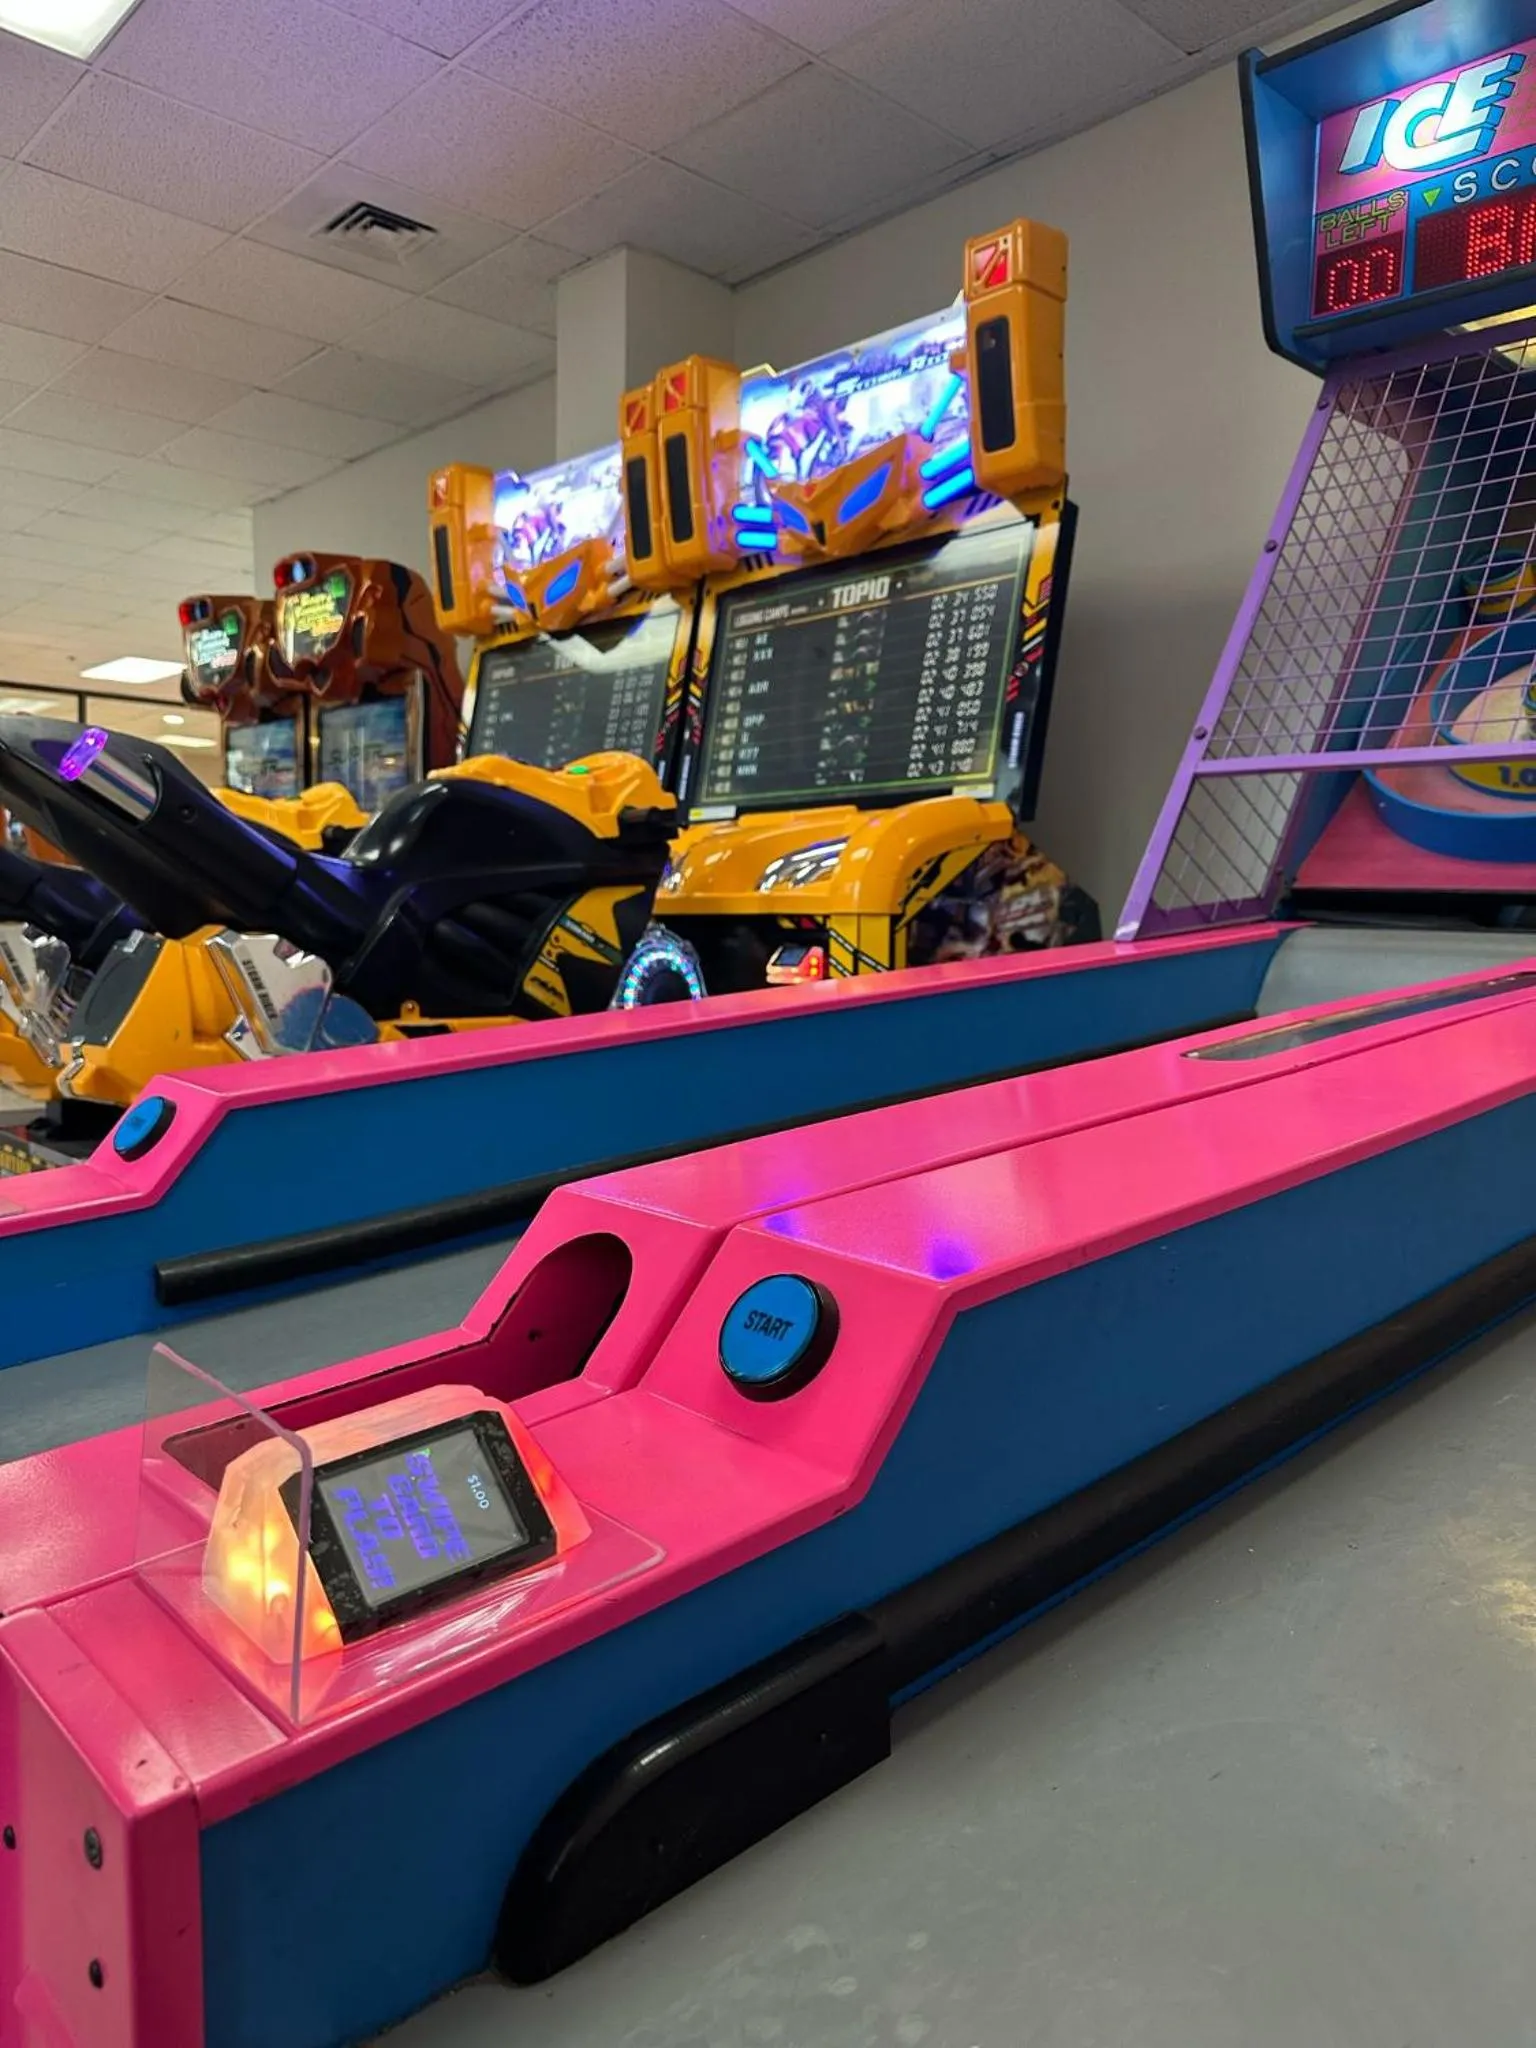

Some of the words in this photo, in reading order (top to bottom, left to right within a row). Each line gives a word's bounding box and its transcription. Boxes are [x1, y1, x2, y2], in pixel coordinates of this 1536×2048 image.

[1338, 53, 1526, 174] ICE
[1453, 158, 1536, 204] SC
[1319, 190, 1407, 232] BALLS
[1325, 211, 1394, 248] LEFT
[1328, 249, 1395, 310] 00
[832, 576, 891, 609] TOP10
[743, 1310, 794, 1342] START
[406, 1452, 472, 1562] SWIPE
[467, 1474, 490, 1510] $1.00
[370, 1493, 405, 1539] TO
[387, 1474, 440, 1559] CARD
